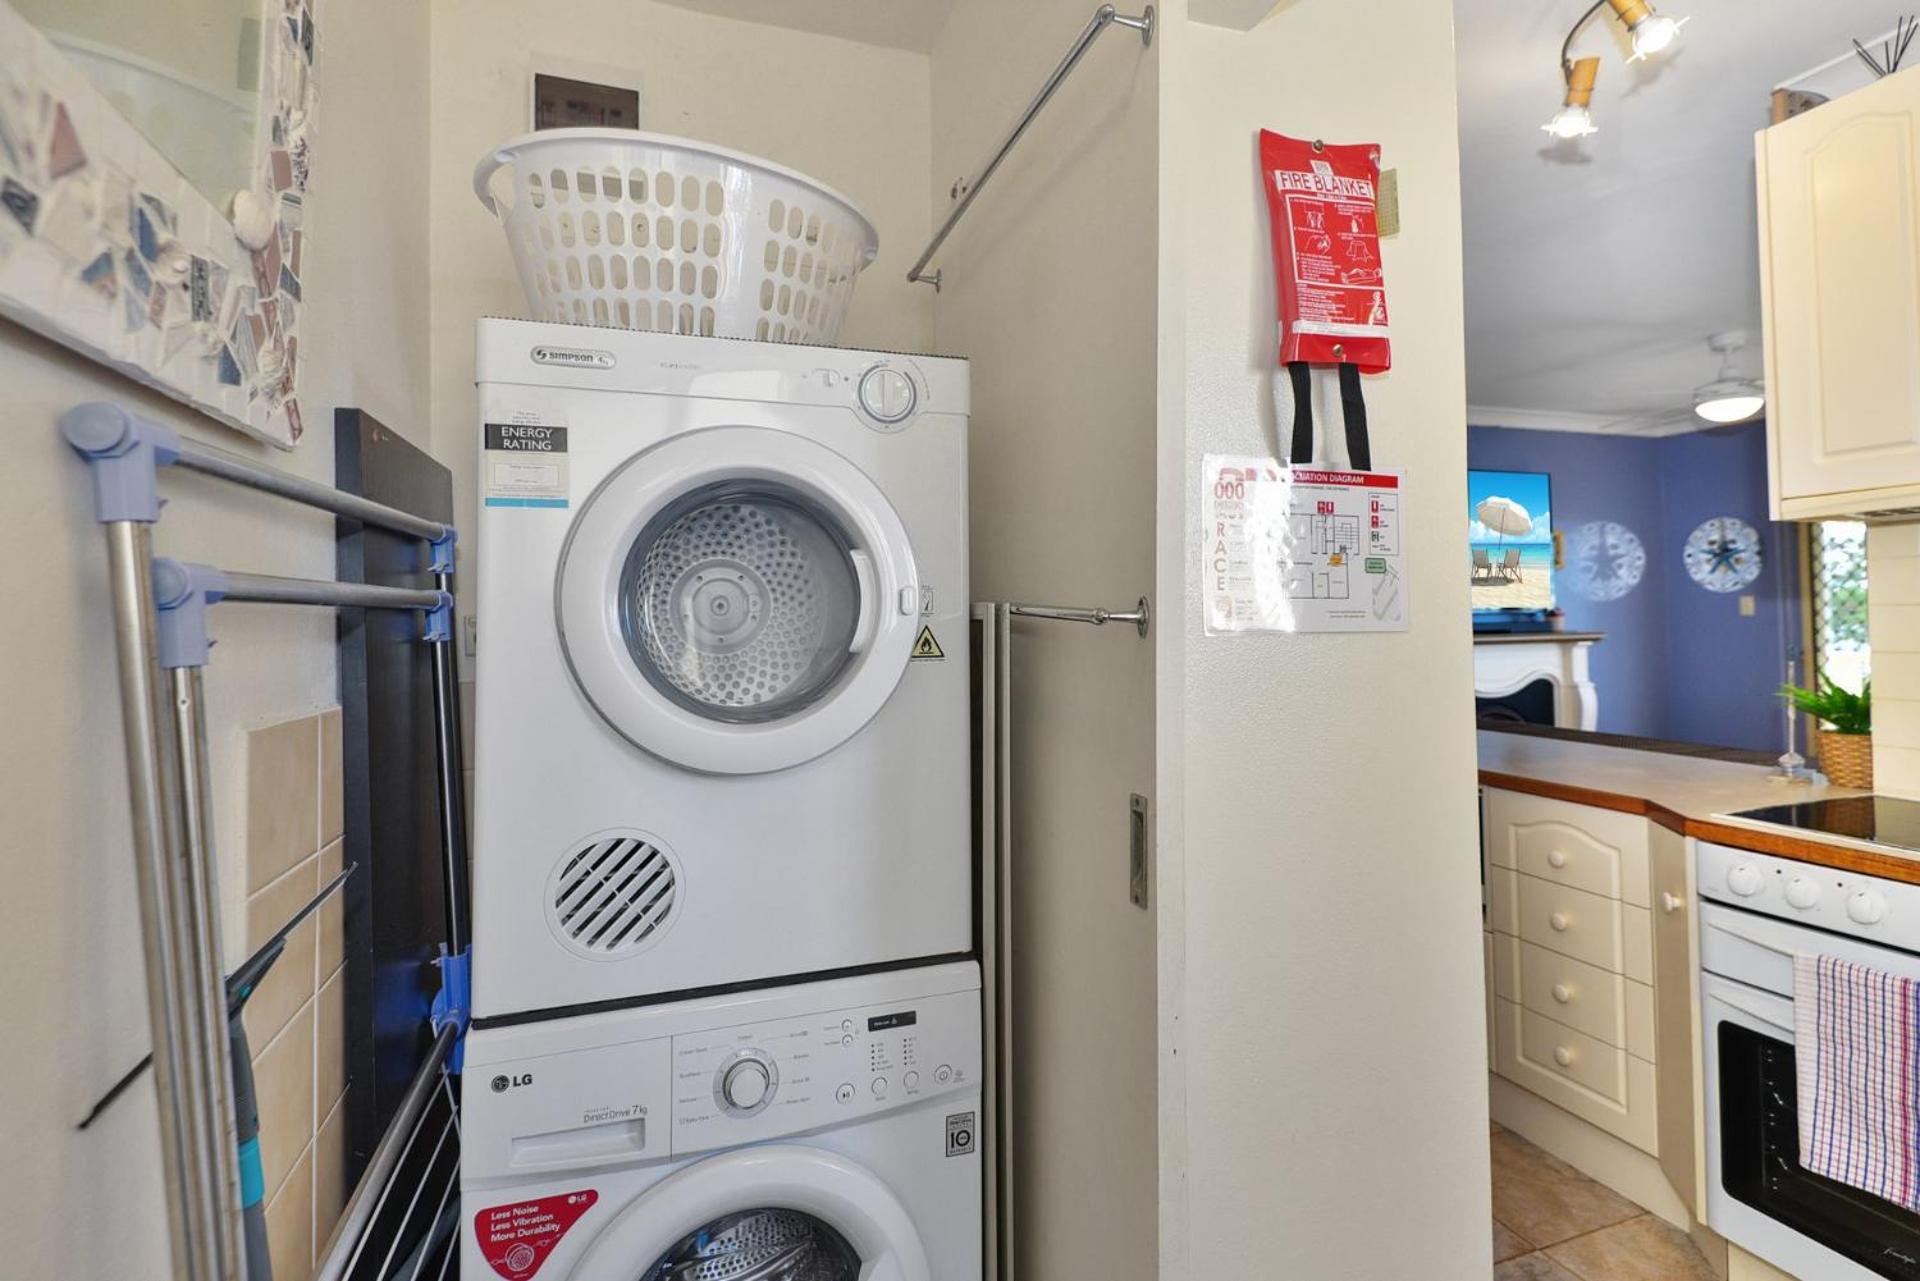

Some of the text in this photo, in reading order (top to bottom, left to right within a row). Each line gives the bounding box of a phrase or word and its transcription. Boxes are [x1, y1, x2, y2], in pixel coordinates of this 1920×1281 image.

[1280, 172, 1311, 191] FIRE
[1313, 176, 1373, 197] BLANKET
[501, 426, 552, 438] ENERGY
[503, 439, 552, 450] RATING
[1329, 474, 1364, 484] DIAGRAM
[1214, 482, 1244, 499] 000
[513, 1073, 533, 1087] LG
[491, 1205, 539, 1221] Less Noise
[491, 1213, 554, 1232] Less Vibration
[491, 1223, 560, 1243] More Durability
